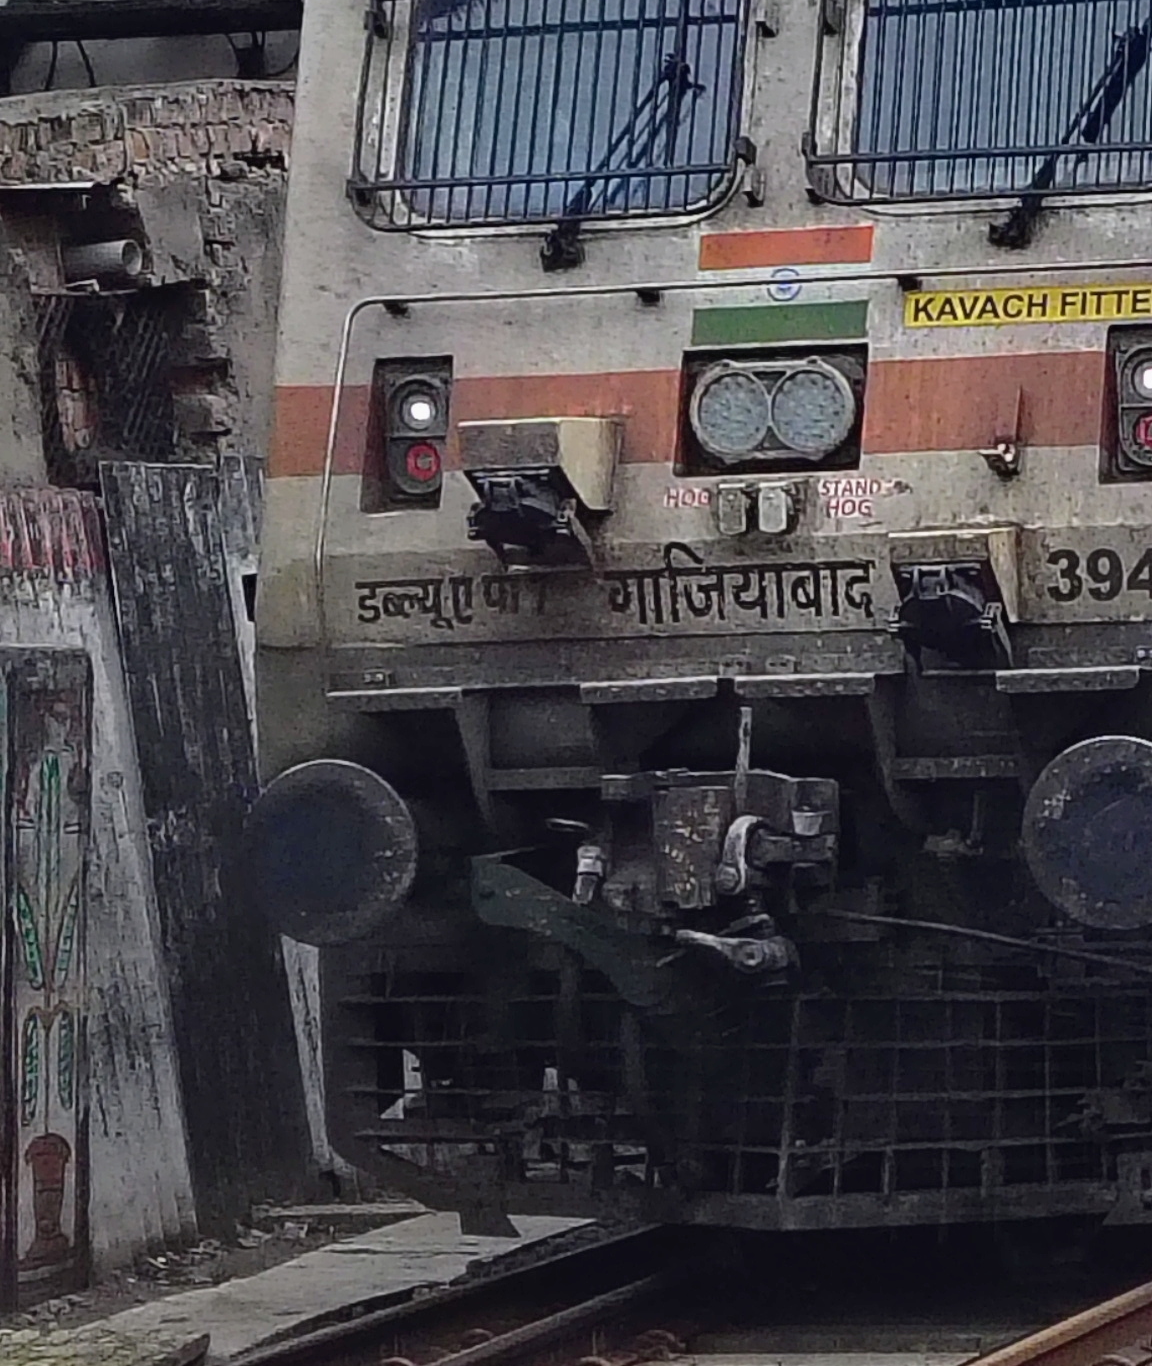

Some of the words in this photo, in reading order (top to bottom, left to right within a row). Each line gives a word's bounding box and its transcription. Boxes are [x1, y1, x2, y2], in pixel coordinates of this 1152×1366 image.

[912, 293, 1049, 323] KAVACH
[820, 479, 881, 497] STAND
[826, 497, 873, 519] HOG
[603, 541, 878, 625] गाजियाबाद
